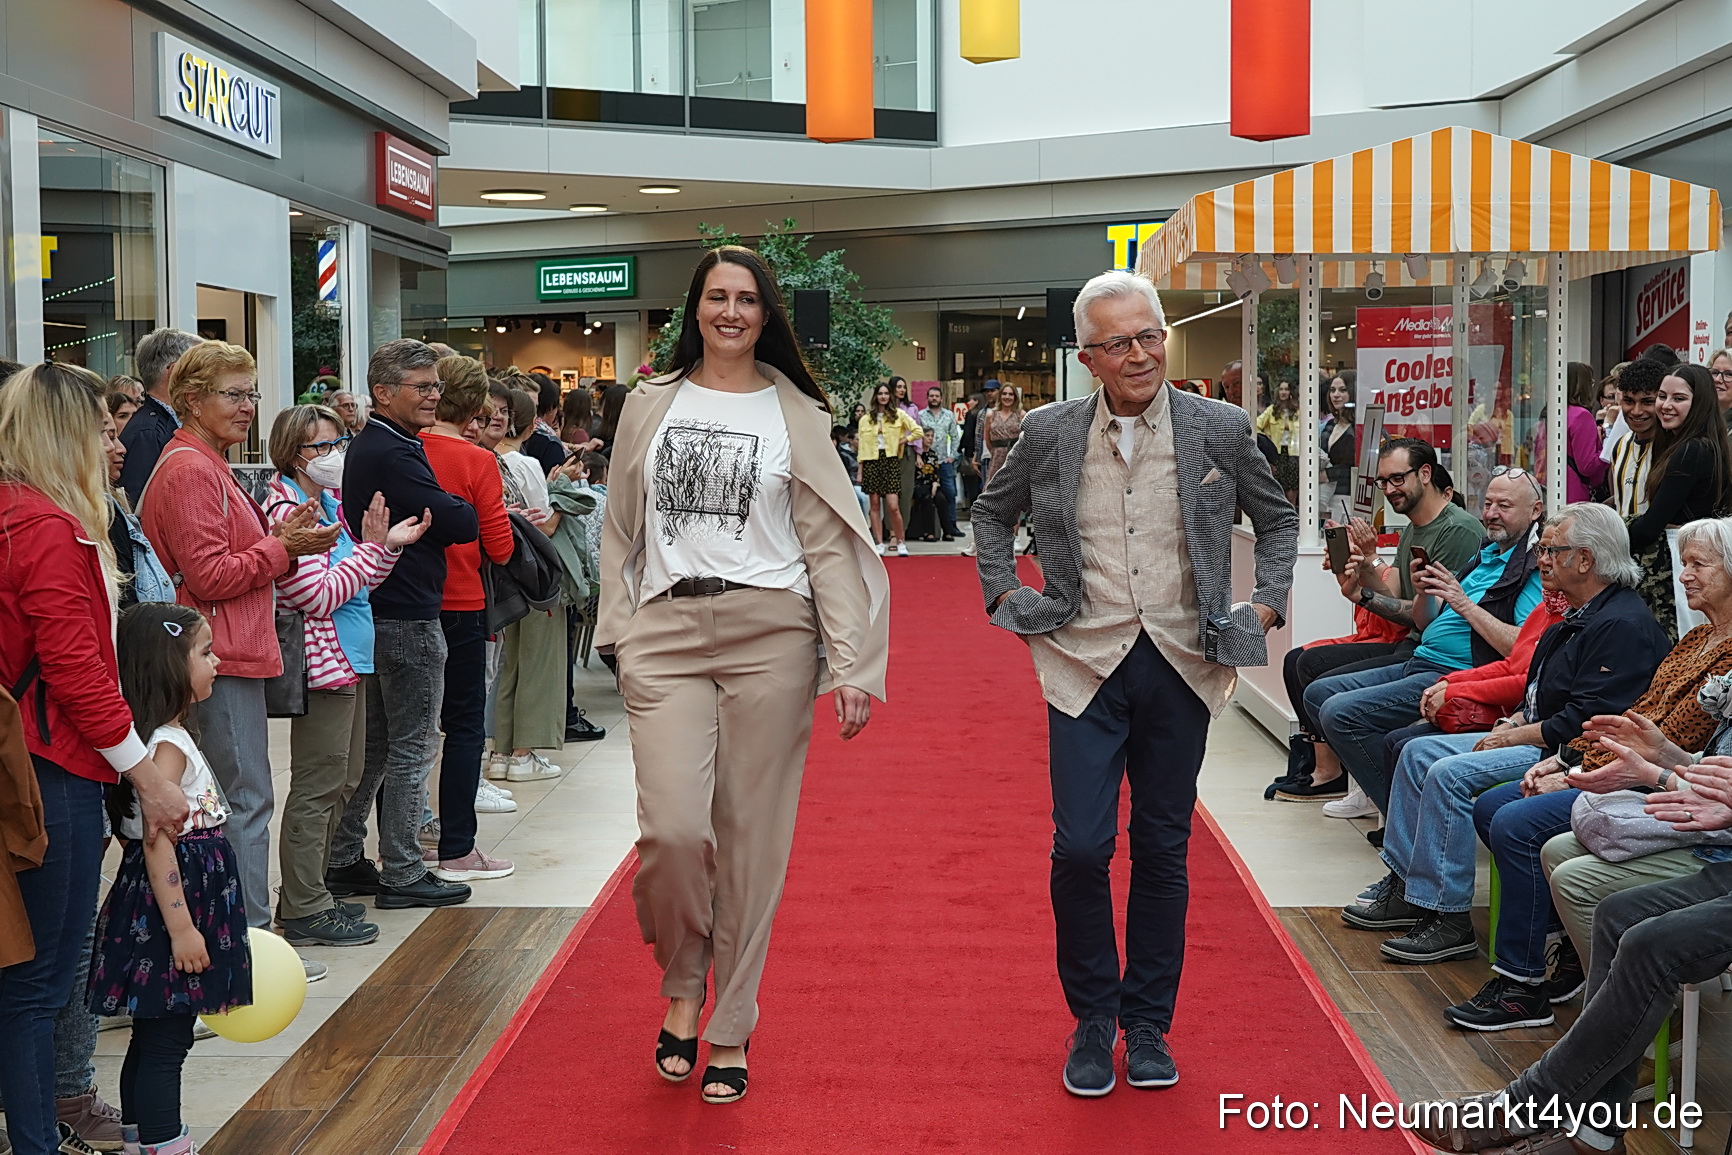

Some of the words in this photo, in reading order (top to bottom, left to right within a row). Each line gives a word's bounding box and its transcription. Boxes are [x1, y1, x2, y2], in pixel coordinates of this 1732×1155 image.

[178, 52, 276, 145] STARCUT
[390, 160, 430, 197] LEBENSRAUM
[545, 270, 623, 287] LEBENSRAUM
[1636, 266, 1685, 337] Service
[948, 322, 971, 334] Kasse
[1384, 353, 1453, 384] Cooles
